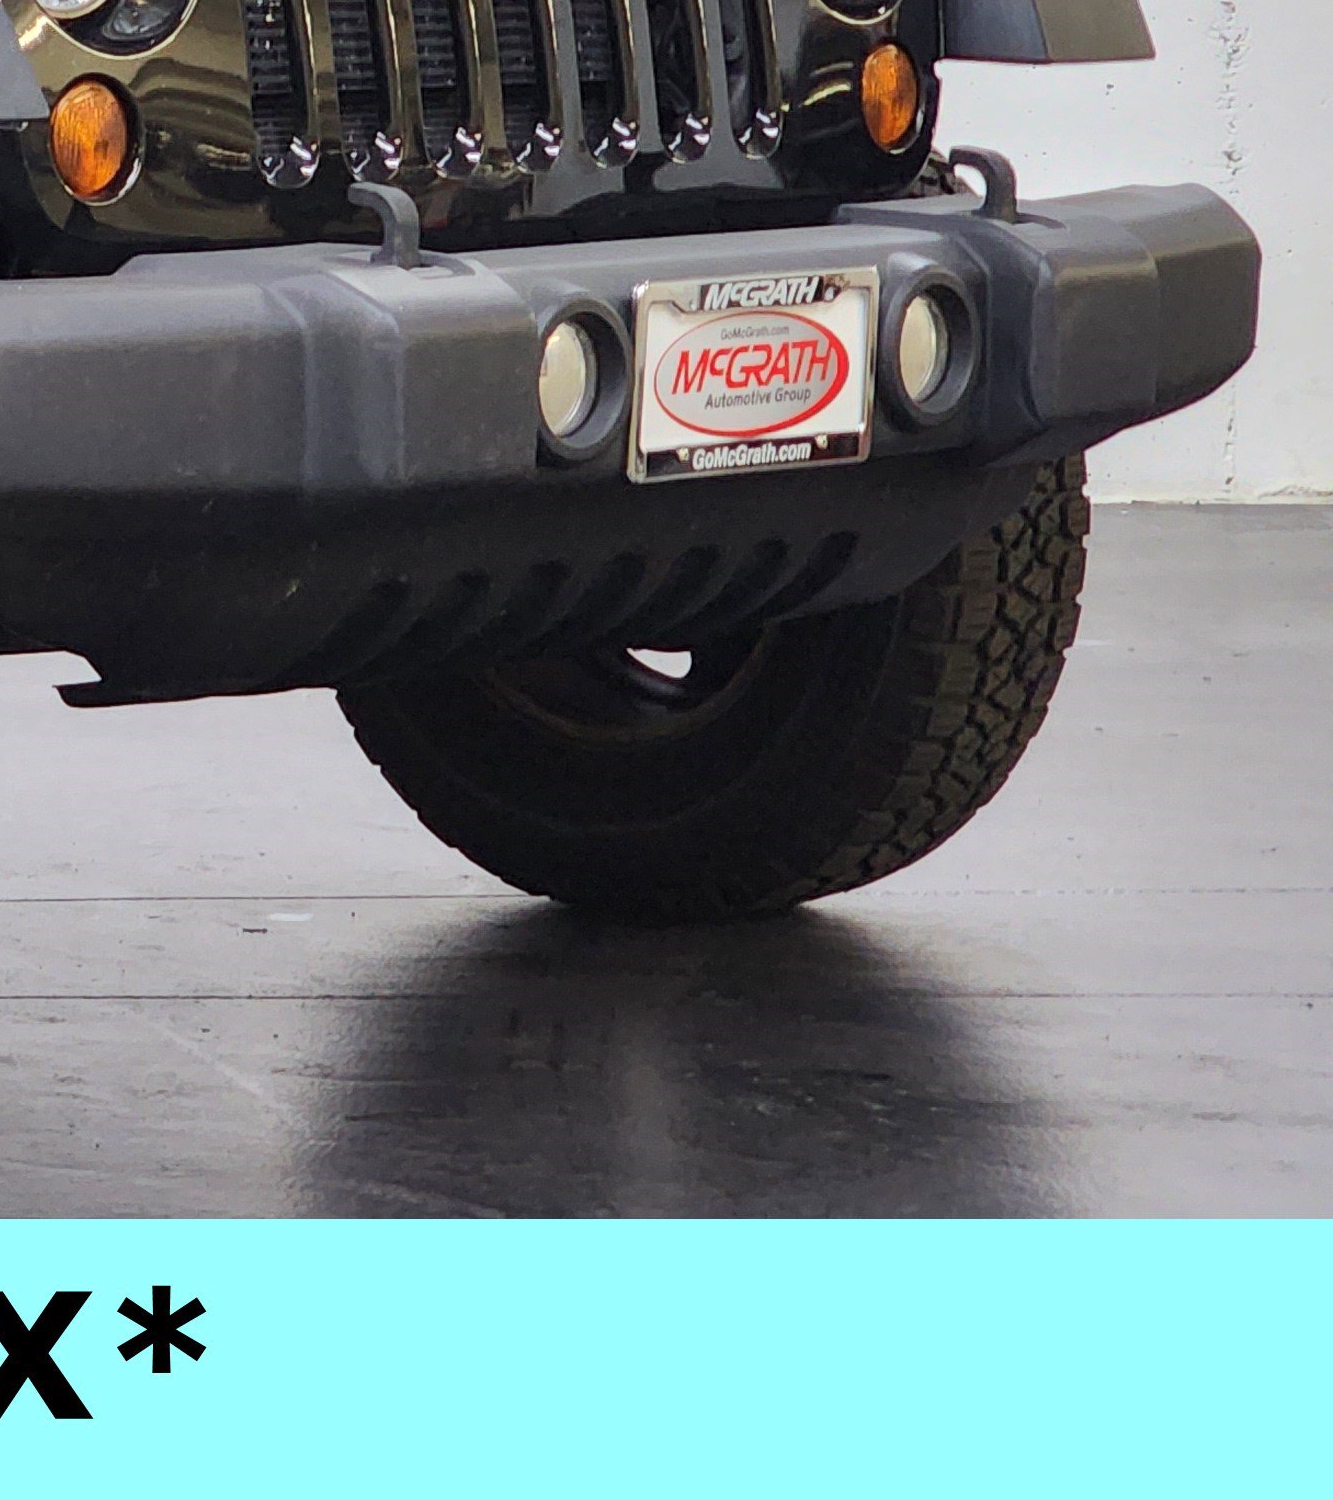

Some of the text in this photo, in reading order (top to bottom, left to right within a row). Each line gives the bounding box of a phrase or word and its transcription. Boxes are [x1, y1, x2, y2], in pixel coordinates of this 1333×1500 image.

[720, 325, 790, 341] GoMcGrath.com
[704, 386, 812, 410] Automotive Group
[692, 442, 811, 470] GoMcGrath.com
